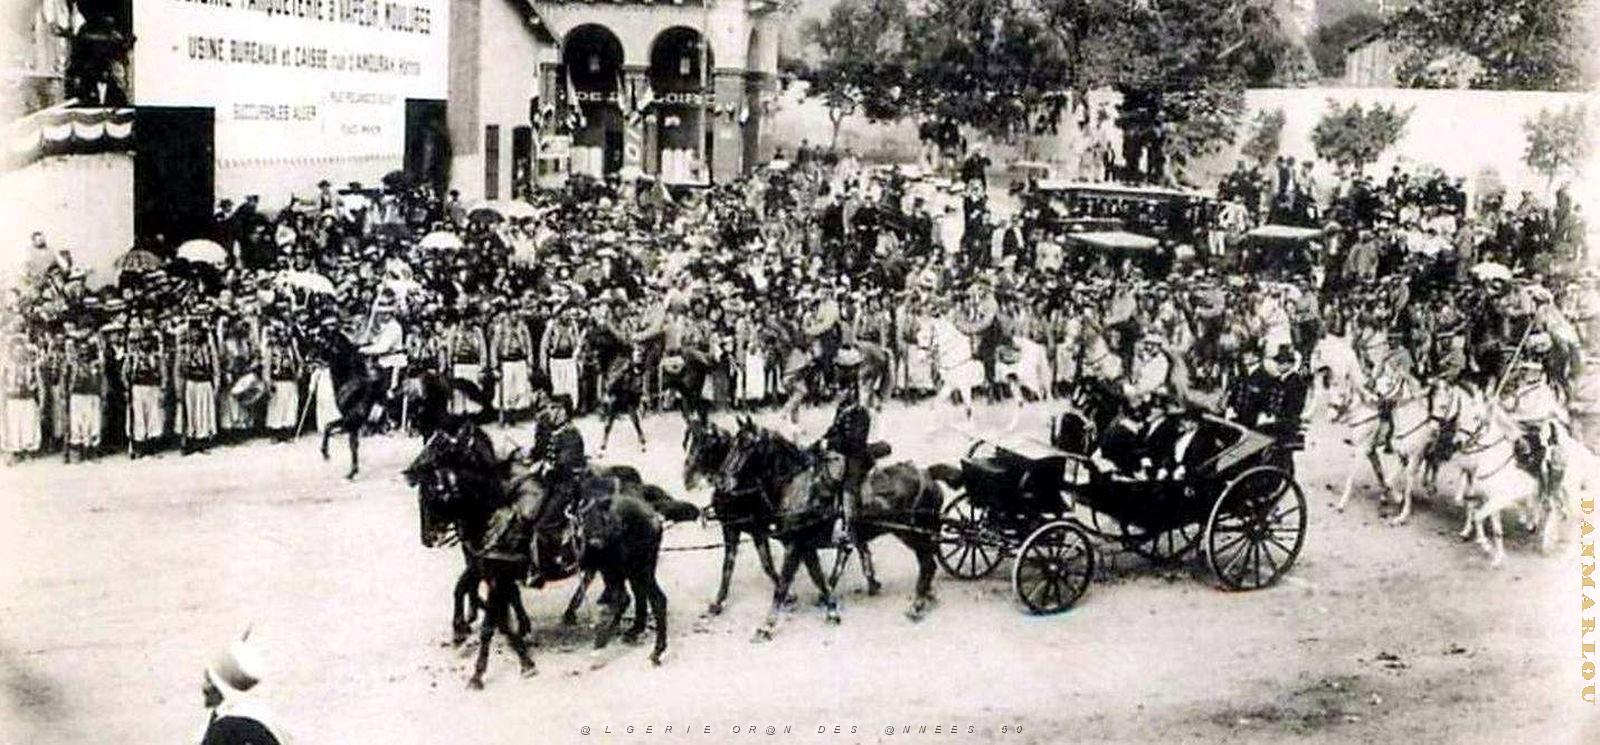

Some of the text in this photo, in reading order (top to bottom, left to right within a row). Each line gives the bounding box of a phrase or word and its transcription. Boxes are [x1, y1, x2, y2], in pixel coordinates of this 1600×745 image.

[188, 36, 224, 60] USINE
[230, 39, 277, 64] BUREAUX
[294, 46, 328, 69] CAISSE
